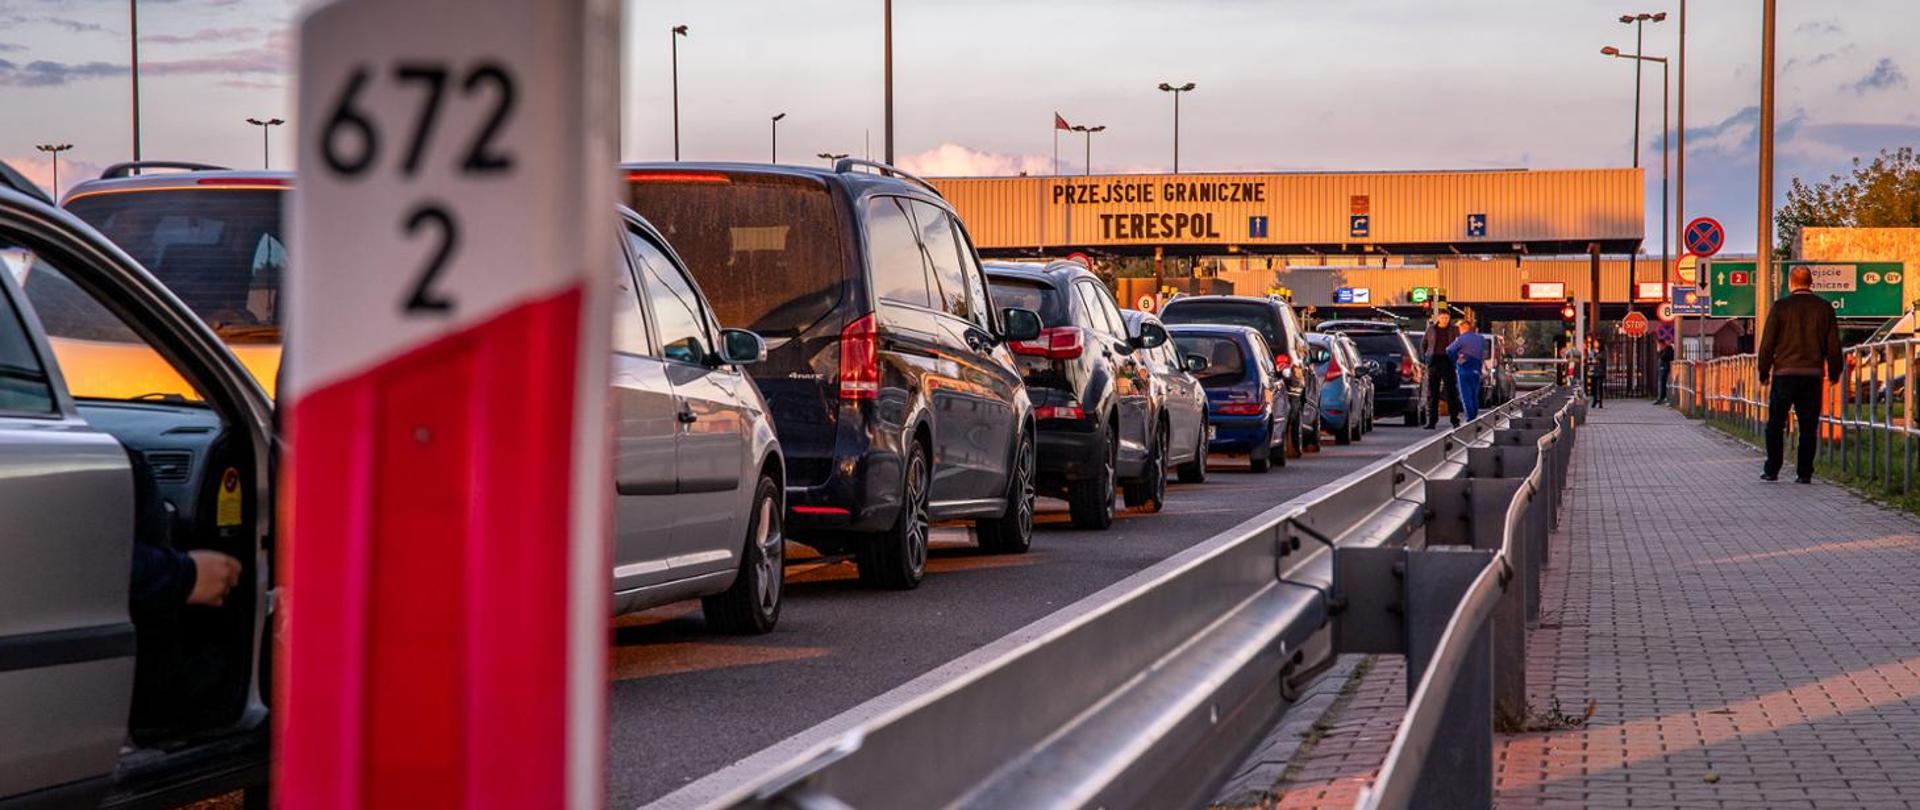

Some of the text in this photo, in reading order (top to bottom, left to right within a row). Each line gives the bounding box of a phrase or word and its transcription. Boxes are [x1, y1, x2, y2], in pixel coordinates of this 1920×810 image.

[320, 62, 517, 179] 672
[1053, 180, 1265, 204] PRZEJŚCIE GRANICZNE
[1100, 213, 1220, 239] TERESPOL
[403, 203, 461, 313] 2
[1735, 273, 1742, 283] 2
[1142, 299, 1150, 309] 8
[1664, 306, 1671, 316] 8
[1625, 320, 1645, 329] STOP
